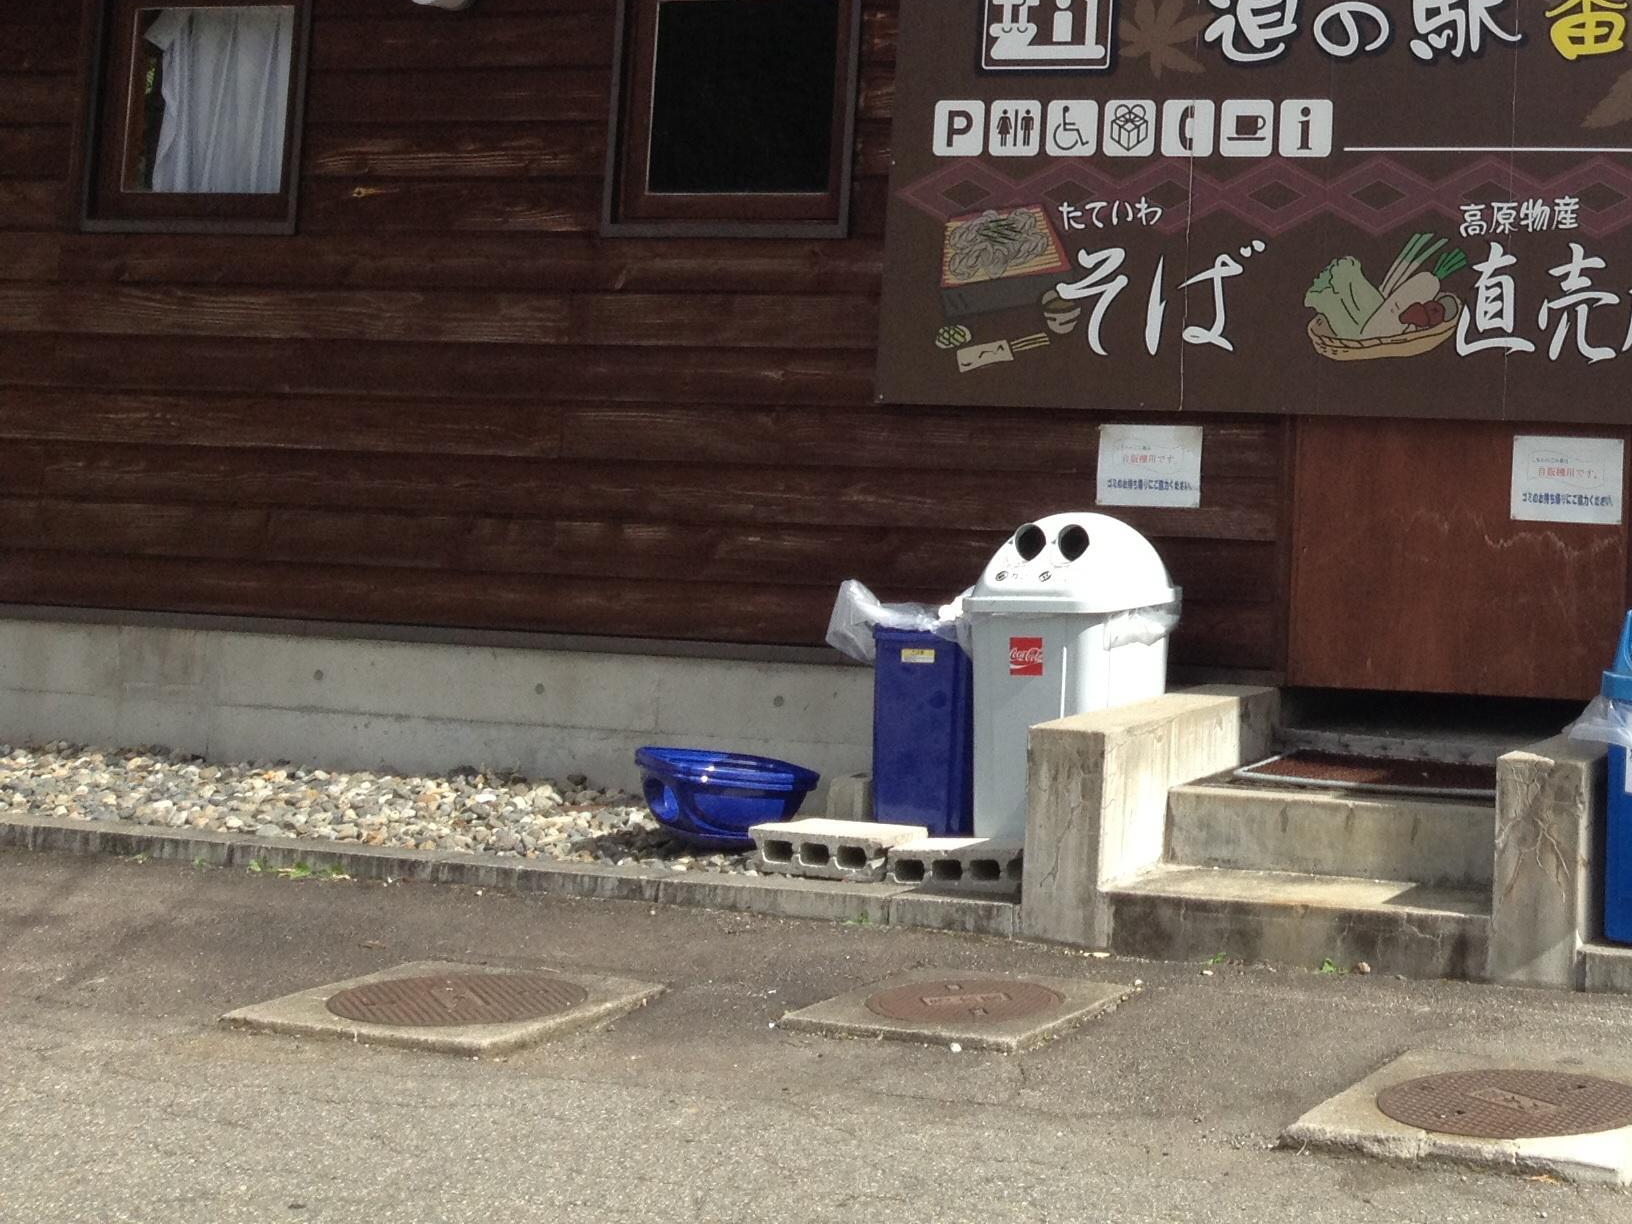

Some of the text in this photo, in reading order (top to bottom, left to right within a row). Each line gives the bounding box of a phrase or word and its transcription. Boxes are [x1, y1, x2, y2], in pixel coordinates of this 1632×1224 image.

[1057, 195, 1163, 231] たていわ
[1458, 195, 1580, 238] 高原物産
[1055, 240, 1266, 356] そば
